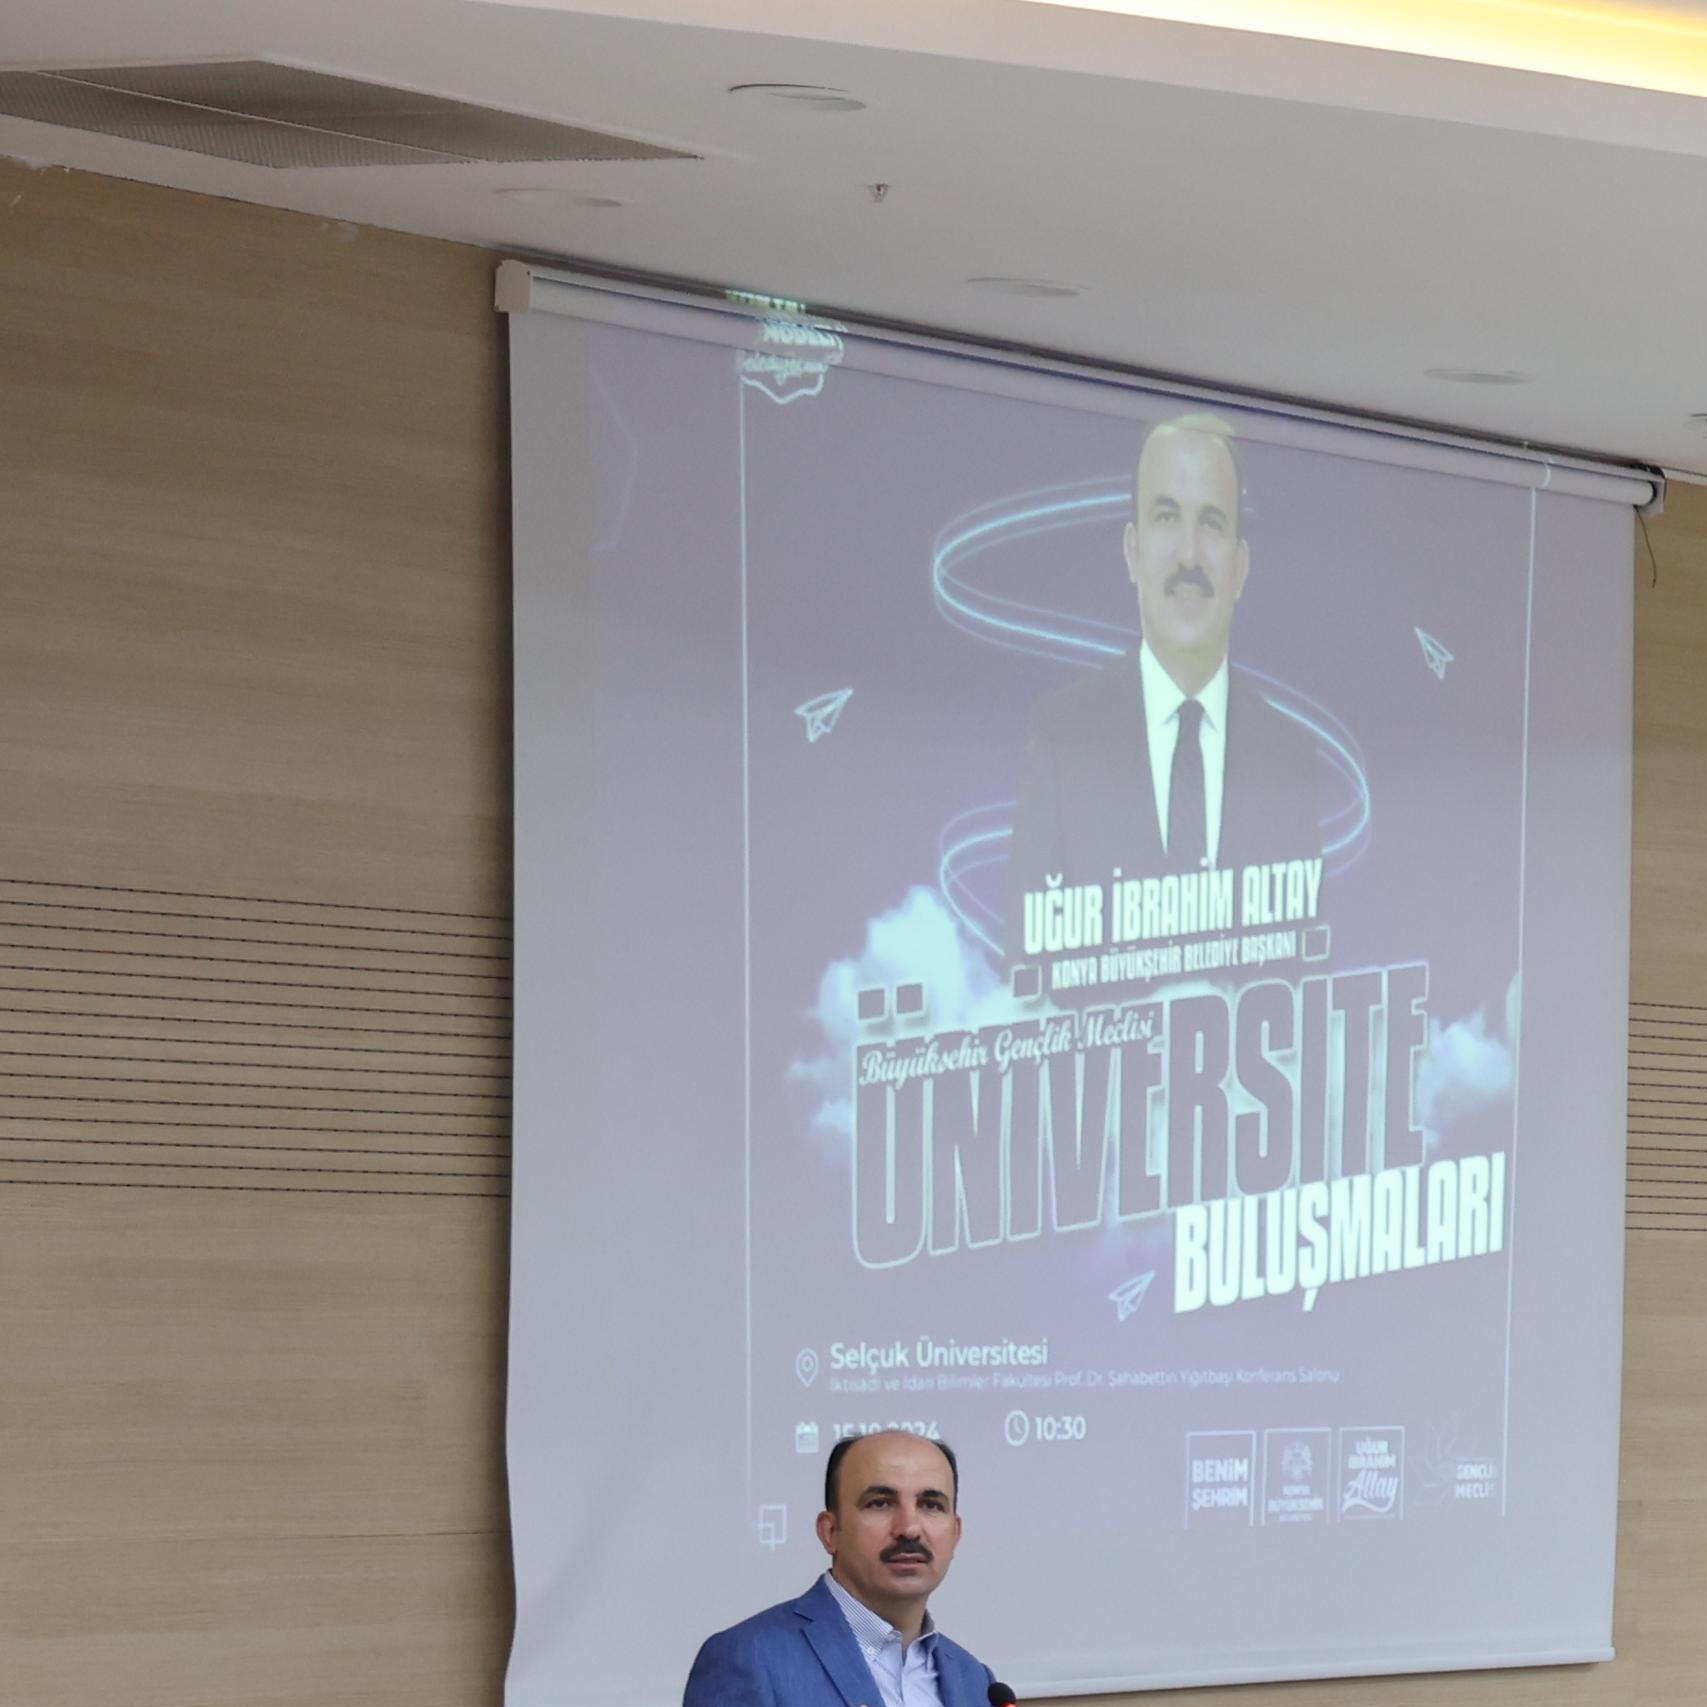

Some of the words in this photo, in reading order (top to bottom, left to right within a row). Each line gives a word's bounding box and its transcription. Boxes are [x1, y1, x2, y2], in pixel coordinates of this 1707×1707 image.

[1024, 872, 1103, 955] UĞUR
[1112, 857, 1233, 943] İBRAHİM
[1241, 858, 1322, 926] ALTAY
[1052, 957, 1098, 989] KONYA
[1174, 1151, 1505, 1313] BULUŞMALARI
[831, 1342, 909, 1374] Selçuk
[917, 1335, 1049, 1368] Üniversitesi
[1035, 1416, 1087, 1441] 10:30
[1192, 1458, 1249, 1483] BENİM
